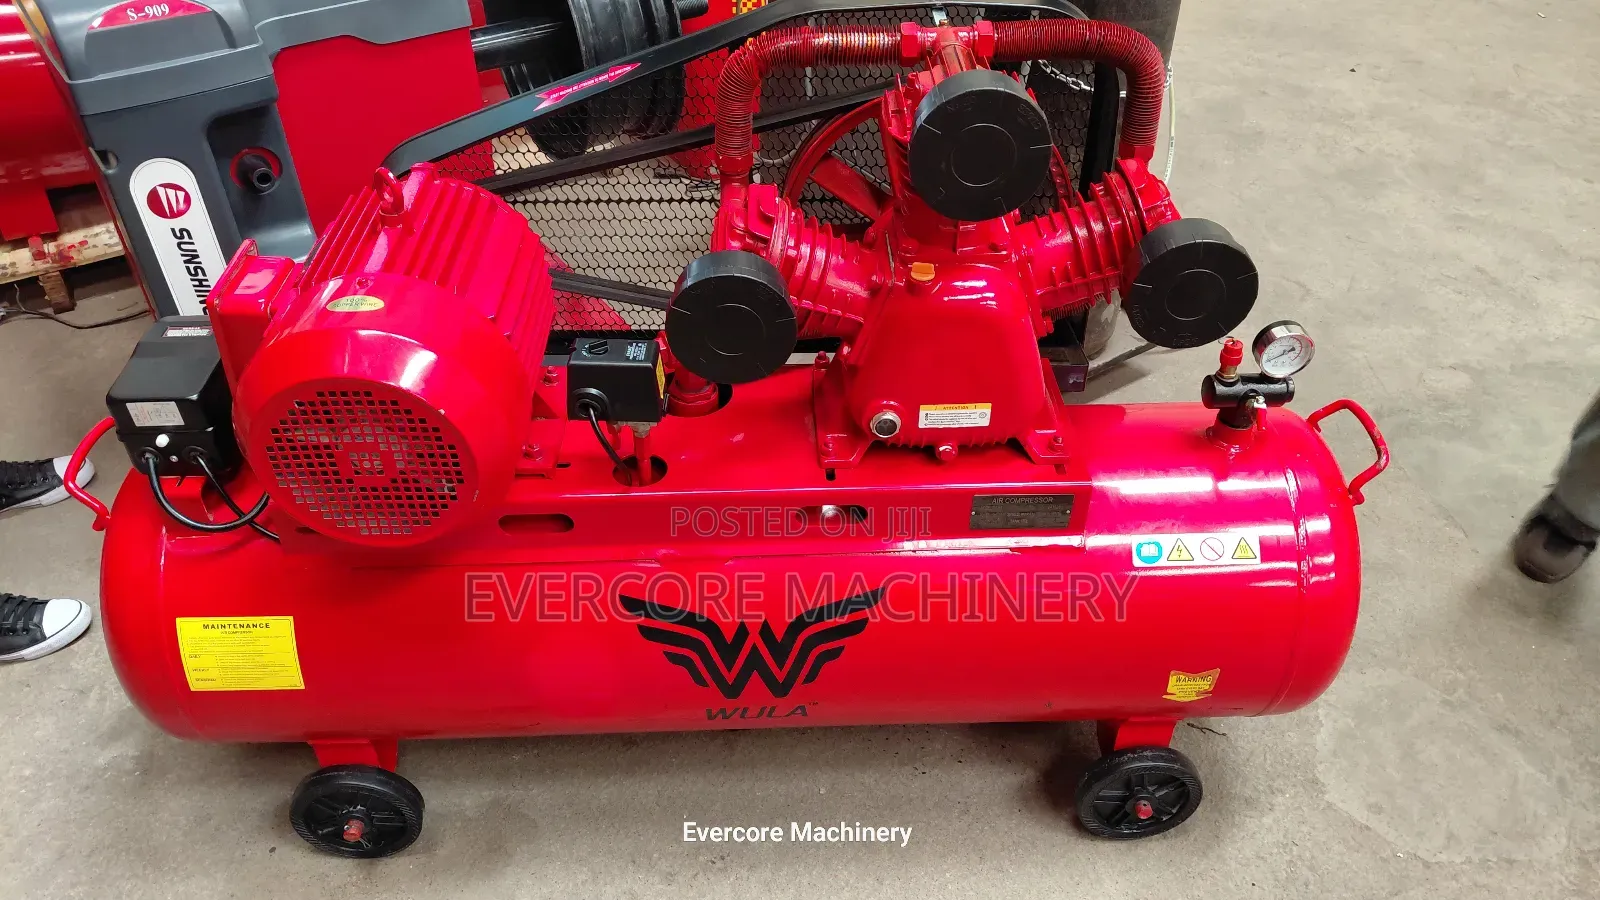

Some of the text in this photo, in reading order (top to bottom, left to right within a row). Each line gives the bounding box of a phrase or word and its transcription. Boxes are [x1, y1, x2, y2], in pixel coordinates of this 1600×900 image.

[126, 3, 170, 21] S-909
[1005, 496, 1054, 504] COMPRESSOR
[202, 622, 271, 630] MAINTENANCE
[1176, 675, 1212, 683] WARNING
[705, 705, 808, 720] WULA
